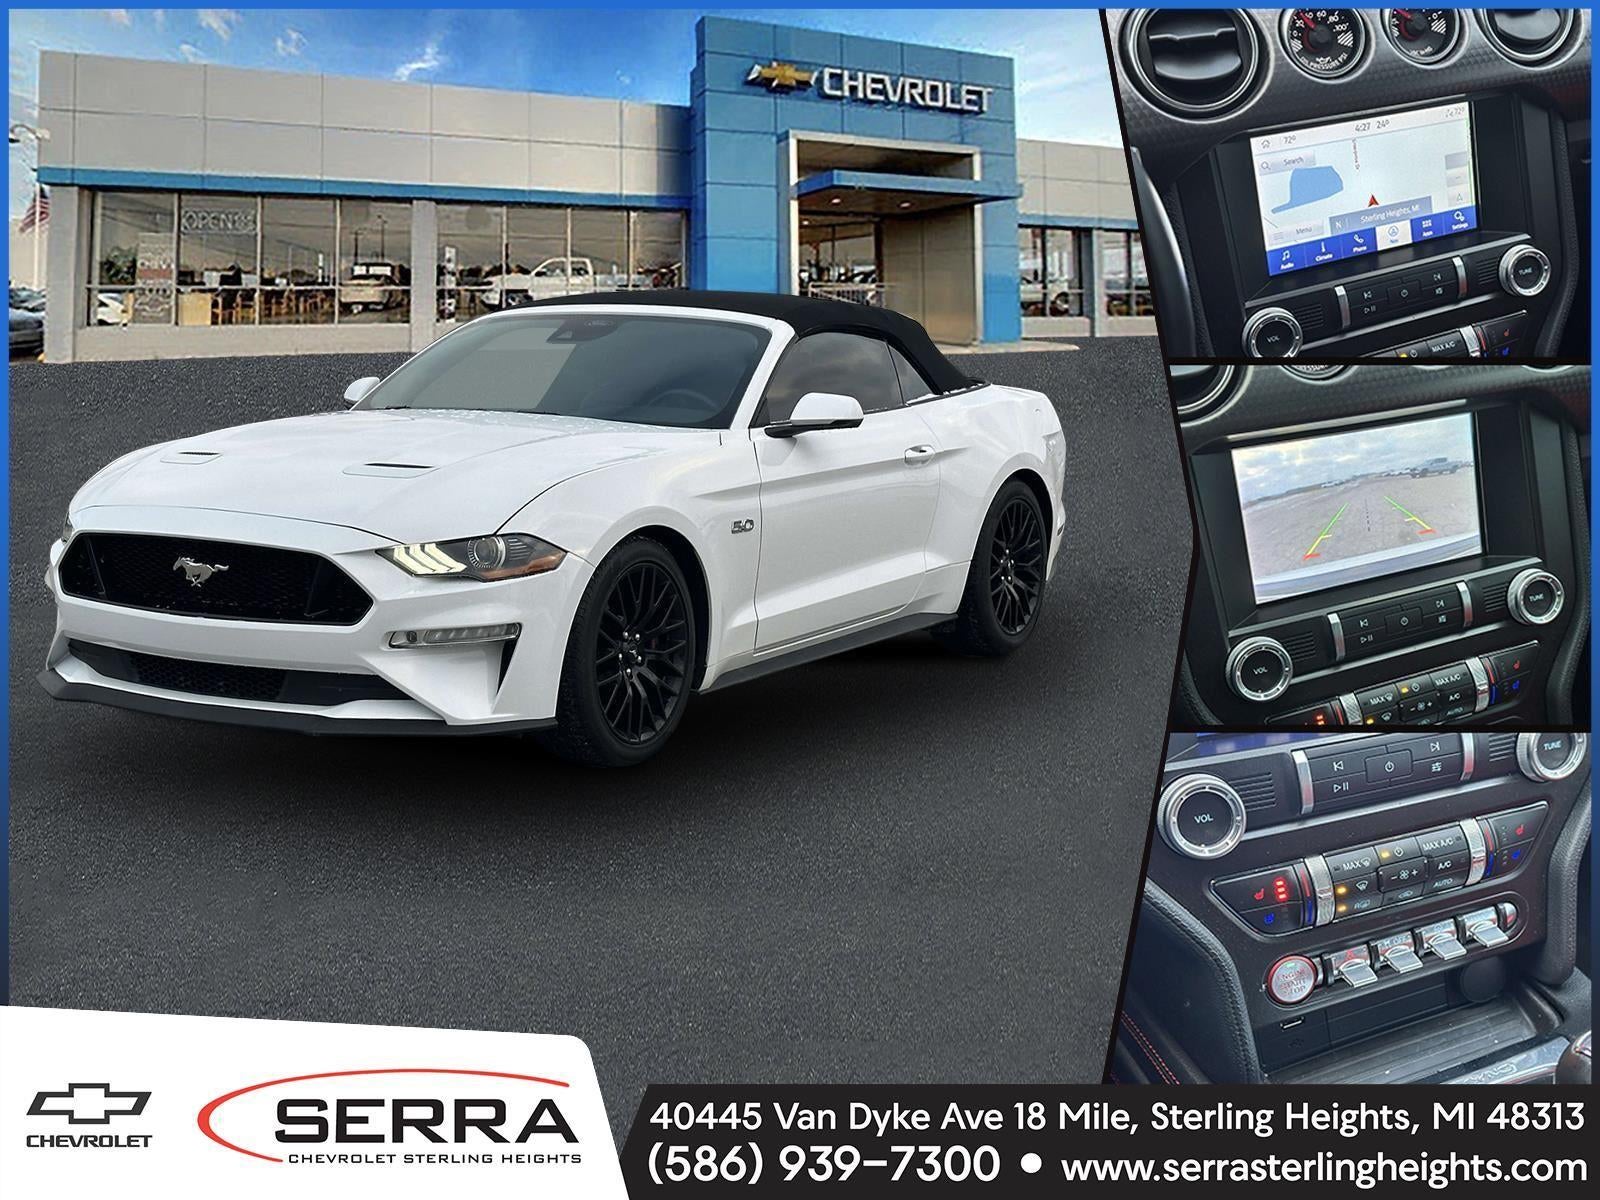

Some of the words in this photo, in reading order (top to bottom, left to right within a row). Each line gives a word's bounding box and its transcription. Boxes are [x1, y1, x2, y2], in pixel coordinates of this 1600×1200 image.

[822, 66, 993, 112] CHEVROLET
[1283, 156, 1305, 167] Search
[1295, 226, 1313, 235] Menu
[1452, 221, 1469, 231] Settings
[1352, 245, 1367, 253] Phone
[1280, 261, 1295, 270] Audio
[1266, 334, 1281, 343] VOL
[1253, 666, 1268, 675] VOL
[1543, 740, 1562, 750] TUNE
[1194, 814, 1214, 824] VOL
[1422, 841, 1440, 851] MAX
[1440, 838, 1454, 847] A/C
[1342, 860, 1362, 871] MAX
[1437, 860, 1452, 870] A/C
[1433, 878, 1453, 888] AUTO
